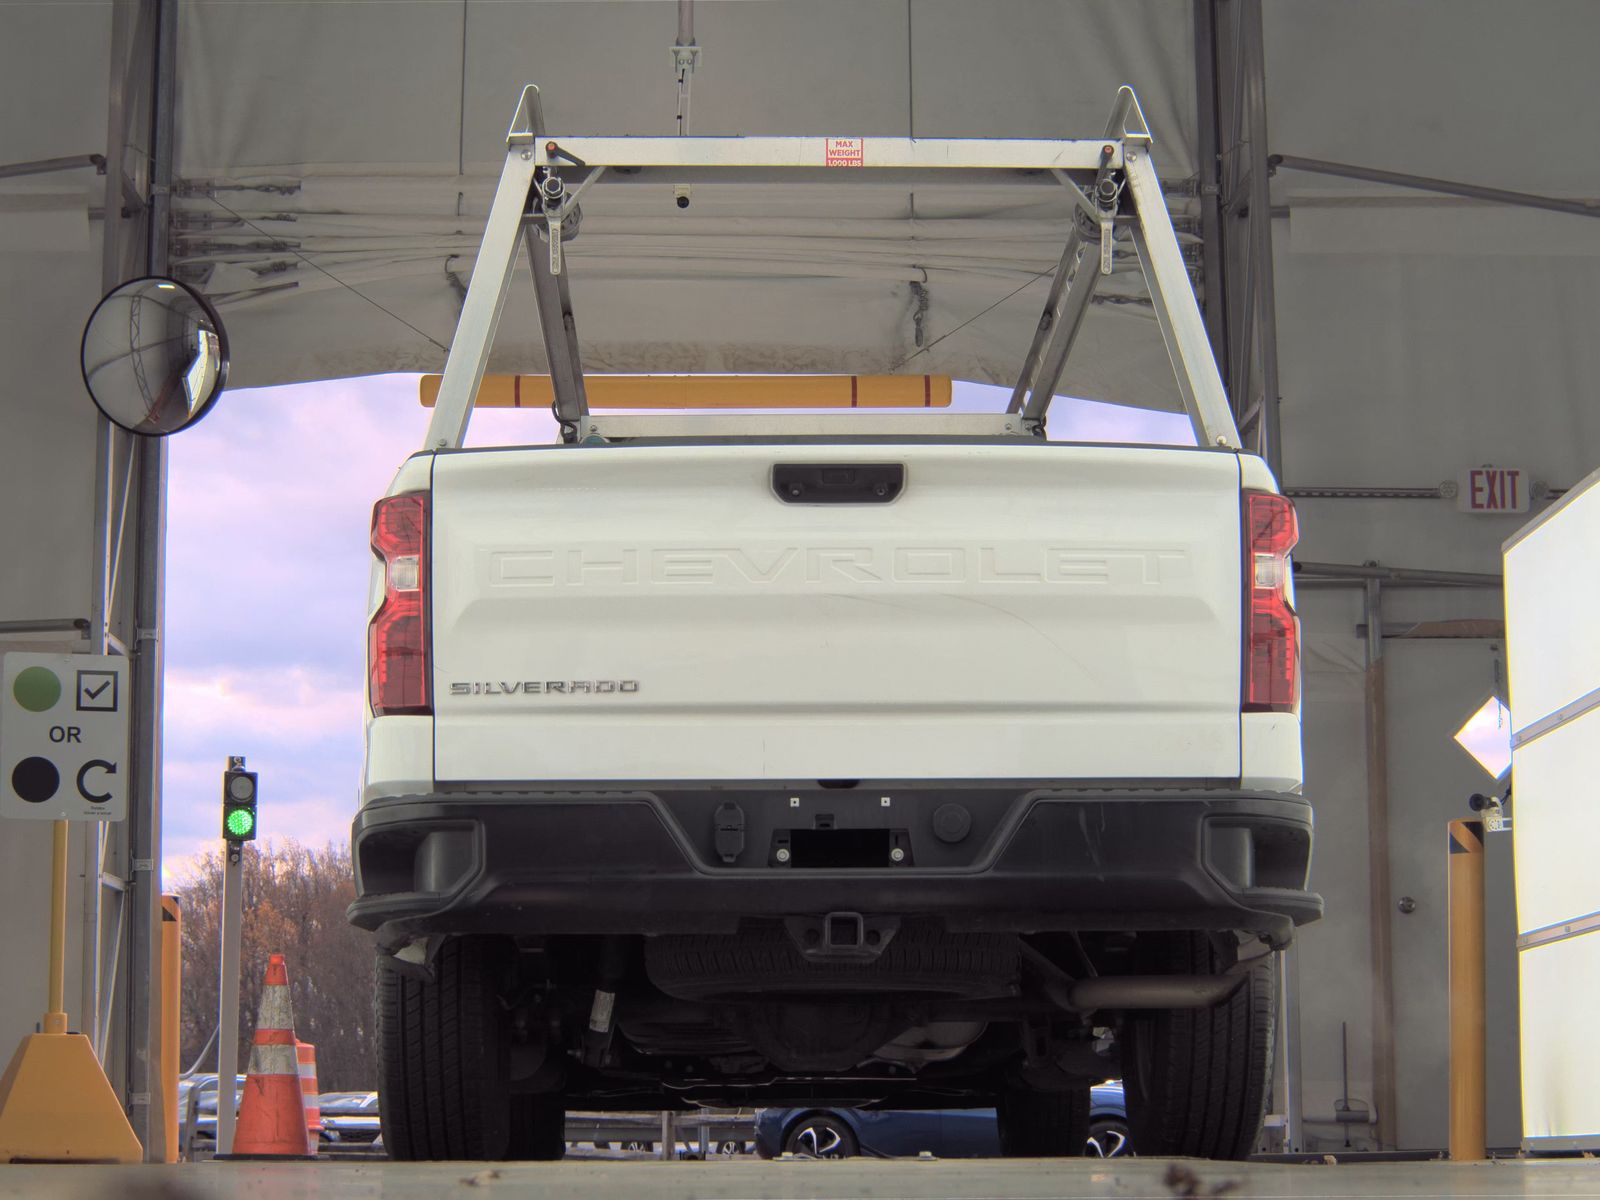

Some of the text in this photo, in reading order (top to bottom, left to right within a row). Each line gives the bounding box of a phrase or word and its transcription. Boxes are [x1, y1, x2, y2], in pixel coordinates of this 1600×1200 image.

[829, 149, 860, 157] WEIGHT
[1470, 470, 1520, 509] EXIT
[489, 547, 1186, 587] CHEVROLET
[450, 681, 640, 695] SILVERADO
[49, 725, 82, 743] OR
